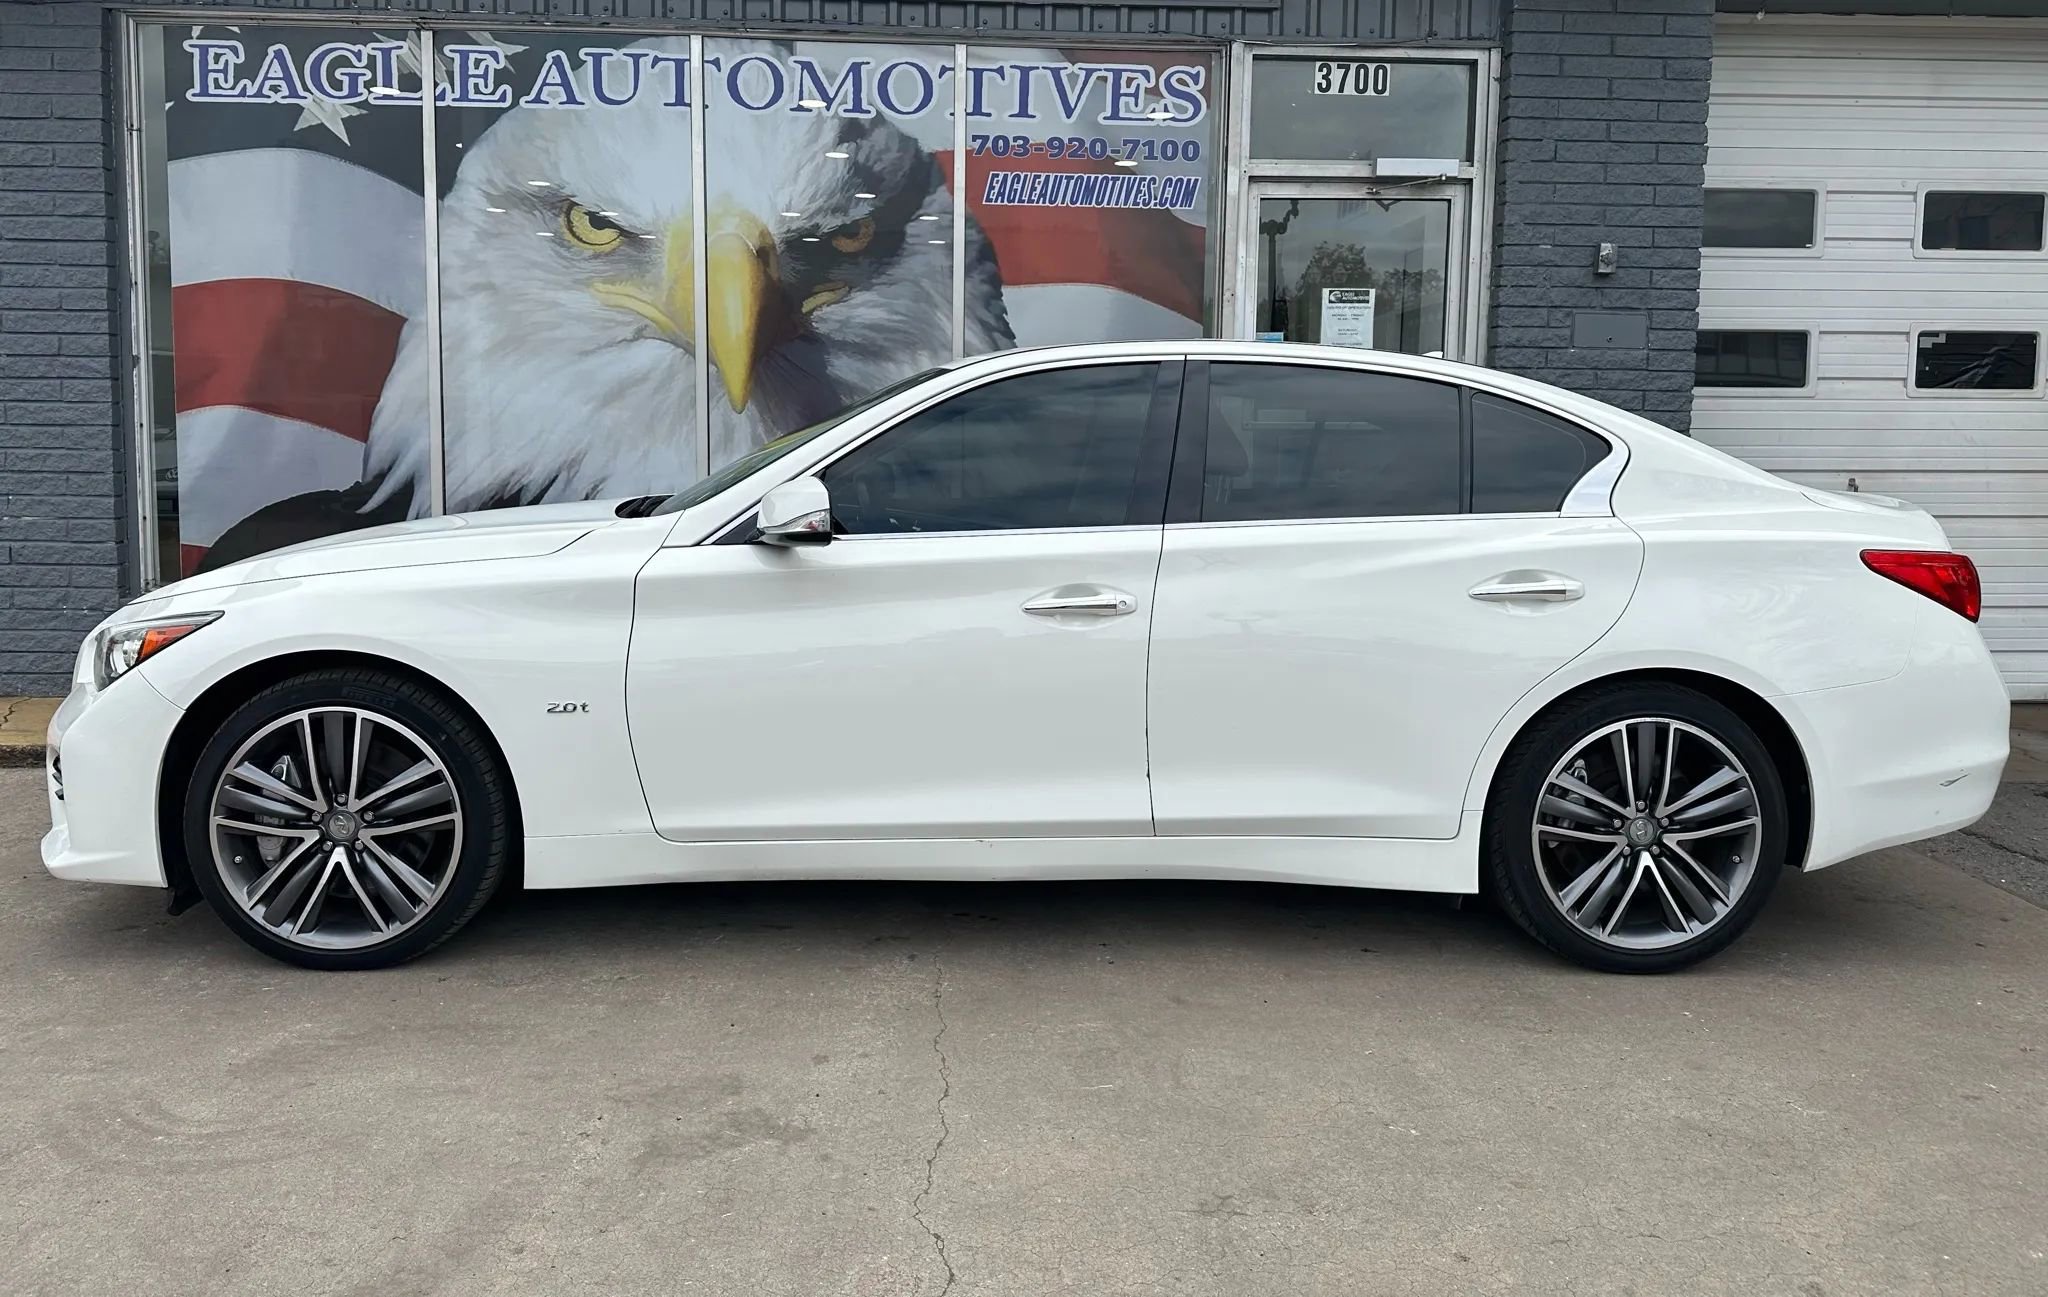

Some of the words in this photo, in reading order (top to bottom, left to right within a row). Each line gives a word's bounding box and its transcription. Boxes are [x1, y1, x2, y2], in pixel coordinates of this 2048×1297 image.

[185, 39, 513, 108] EAGLE
[522, 46, 1206, 126] AUTOMOTIVES
[1317, 62, 1389, 95] 3700
[970, 133, 1201, 162] 703-920-7100
[982, 171, 1202, 210] EAGLEAUTOMOTIVES.COM
